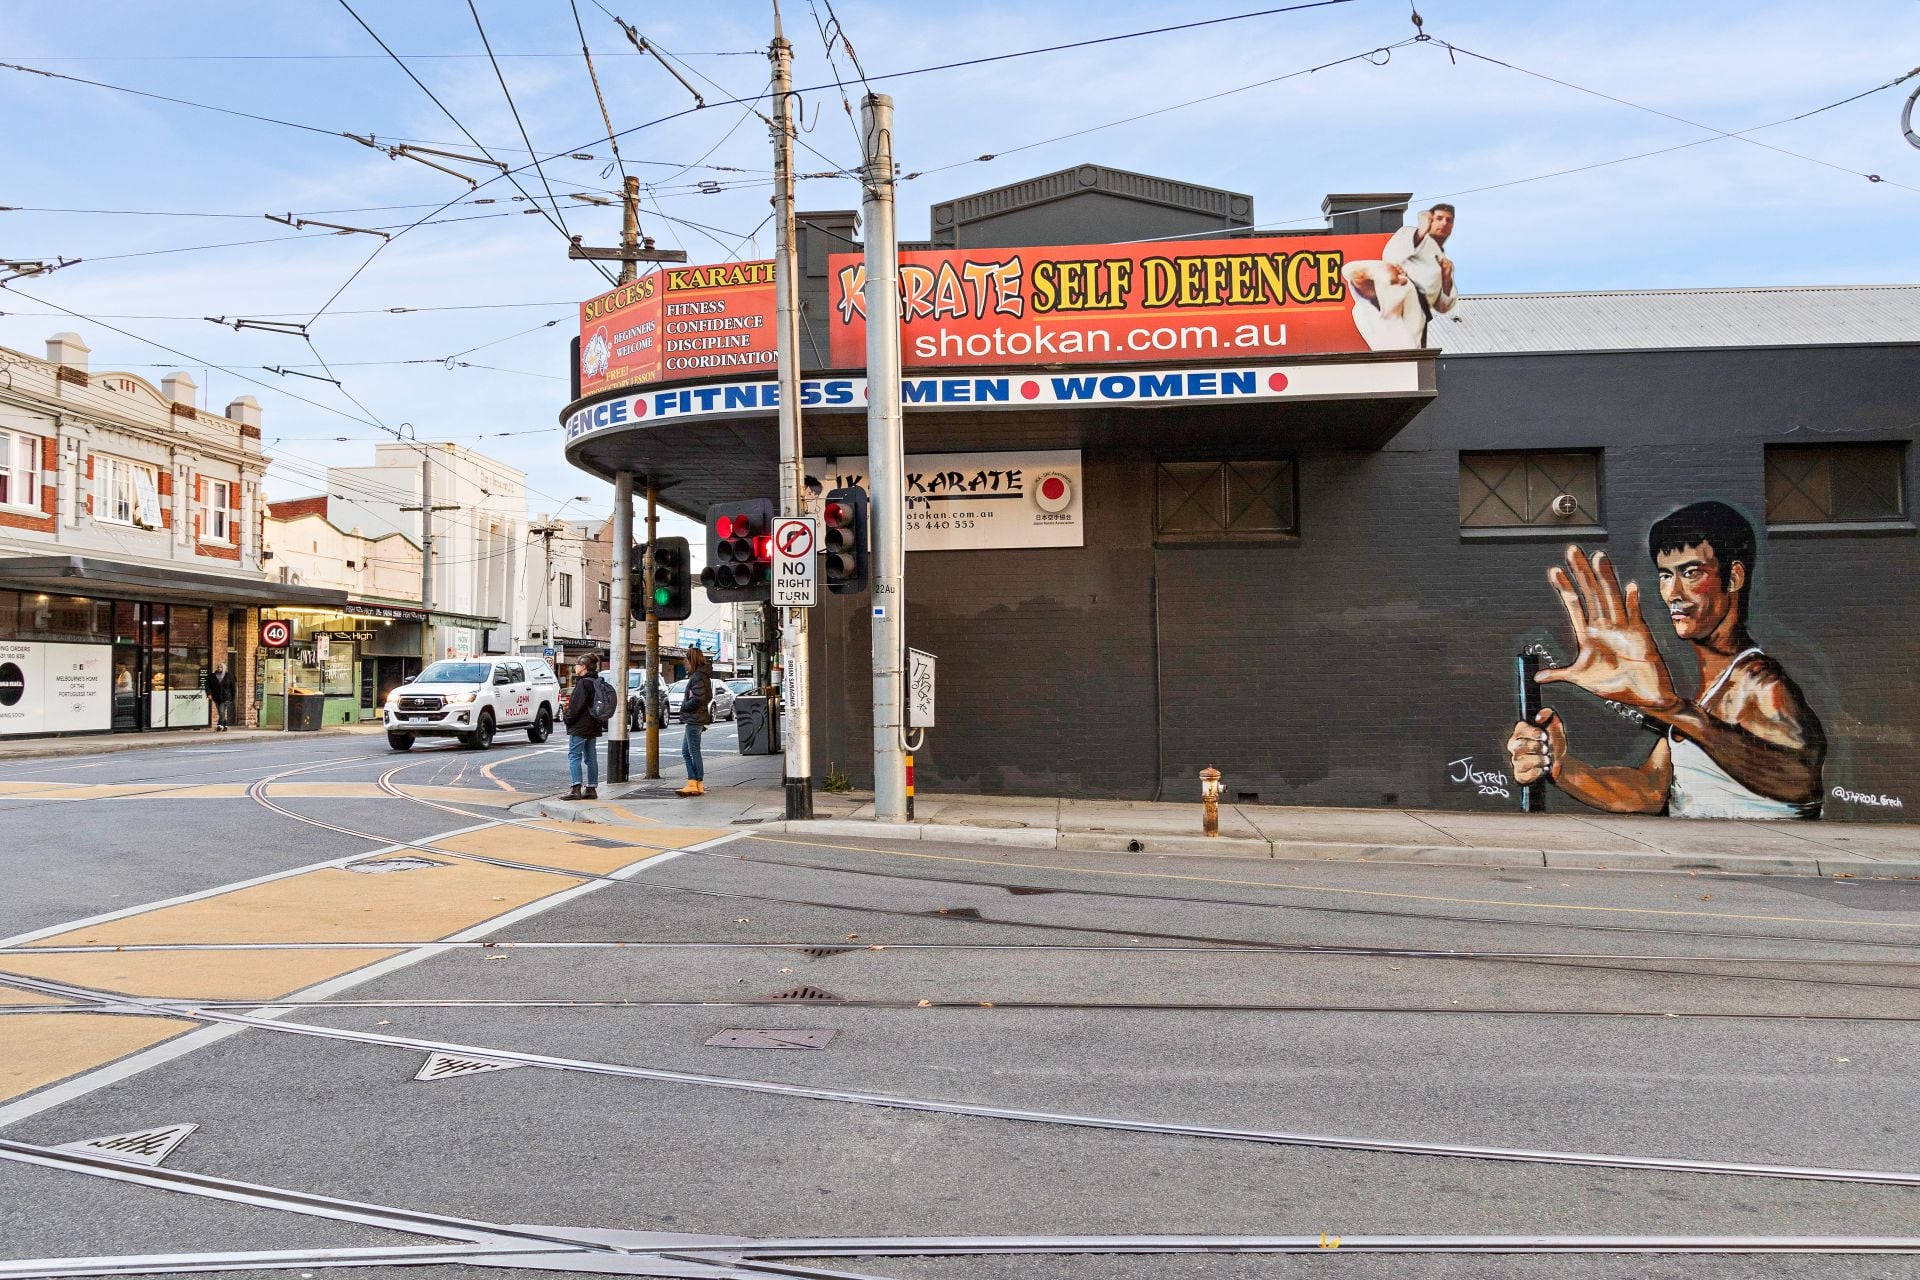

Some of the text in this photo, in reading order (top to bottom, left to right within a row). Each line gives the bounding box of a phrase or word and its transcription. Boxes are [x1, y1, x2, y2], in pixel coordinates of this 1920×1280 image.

[837, 250, 1345, 325] KRATE SELF DEFENCE
[585, 277, 654, 321] SUCCESS
[666, 300, 726, 317] FITNESS
[613, 320, 656, 344] BEGINNERS
[666, 315, 763, 334] CONFIDENCE
[616, 337, 653, 358] WELCOME
[666, 334, 750, 352] DISCIPLINE
[916, 324, 1286, 359] shotokan.com.au
[605, 366, 629, 382] FREE!
[902, 379, 1009, 402] MEN
[1051, 372, 1256, 400] WOMEN
[906, 470, 1023, 493] KARATE
[906, 510, 994, 520] otokan.com.au
[906, 520, 975, 530] 38 440 555
[783, 562, 805, 575] NO
[778, 579, 811, 588] RIGHT
[779, 592, 809, 600] TURN
[269, 629, 284, 638] 40
[352, 633, 372, 641] High
[516, 695, 529, 703] JOHN
[505, 707, 529, 716] HOLLAND
[1478, 785, 1510, 798] 2020
